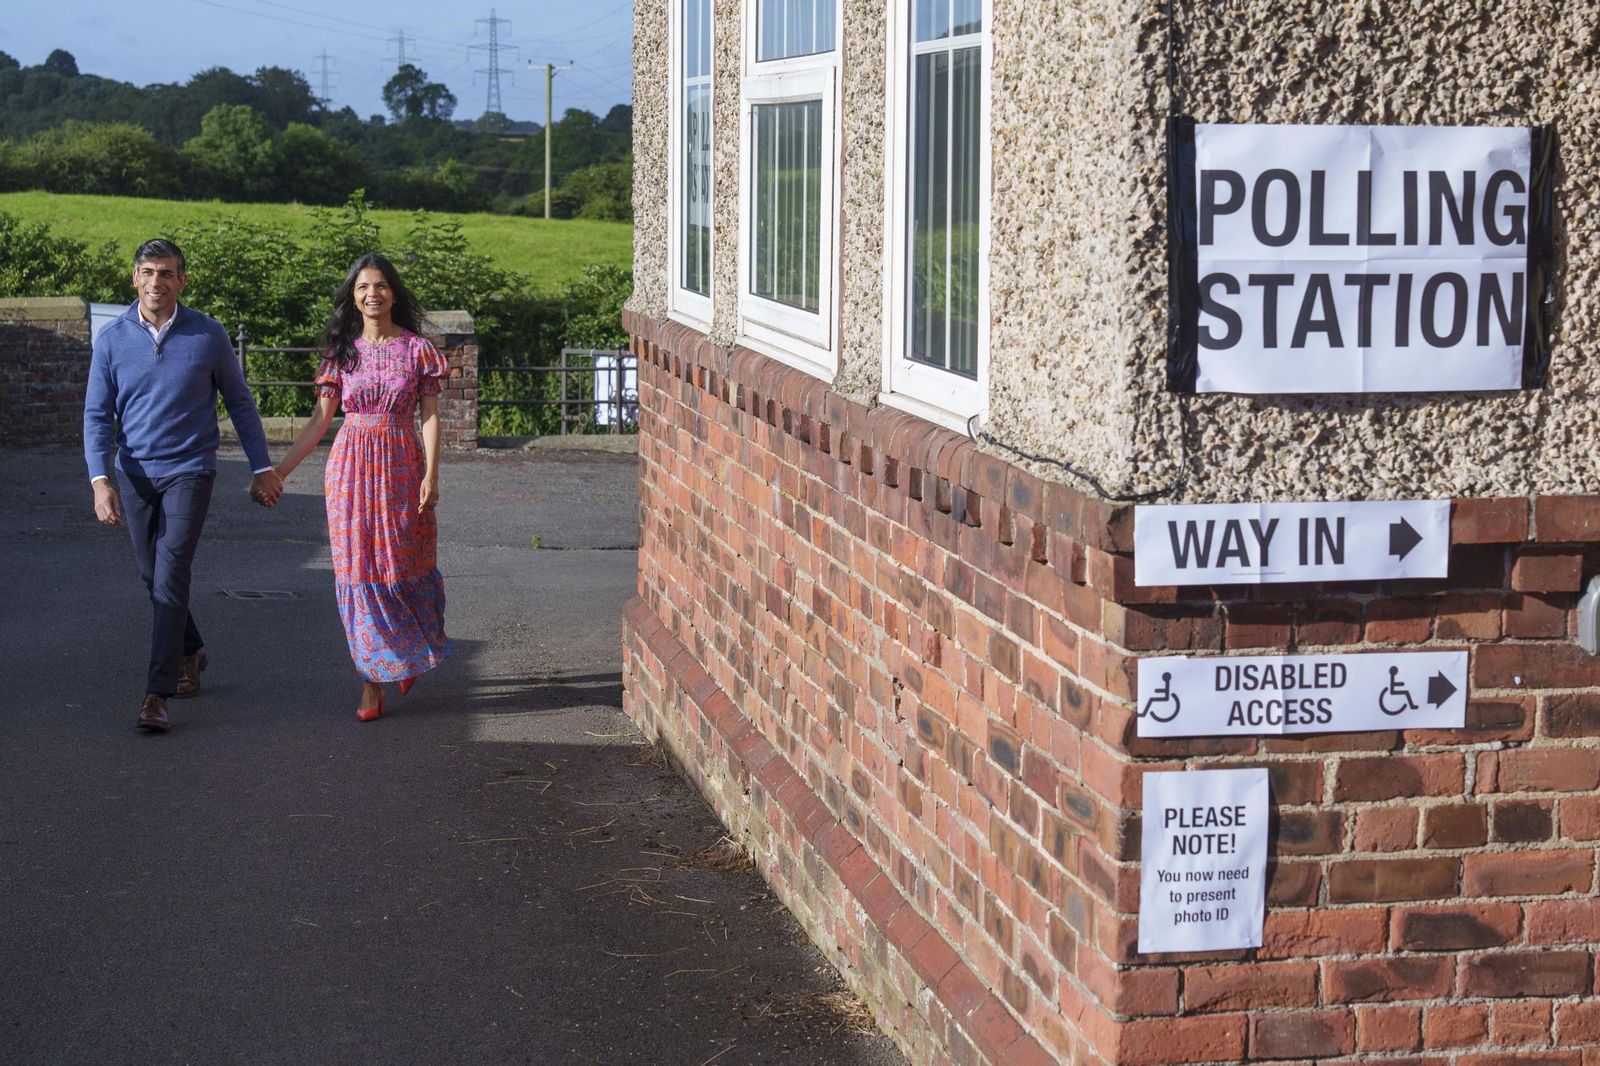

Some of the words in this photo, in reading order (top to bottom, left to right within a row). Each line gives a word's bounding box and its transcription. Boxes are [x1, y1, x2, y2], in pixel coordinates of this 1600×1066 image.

[1199, 168, 1527, 247] POLLING
[1197, 271, 1525, 350] STATION
[1167, 518, 1280, 569] WAY
[1298, 516, 1346, 566] IN
[1214, 662, 1347, 692] DISABLED
[1226, 697, 1333, 727] ACCESS
[1164, 805, 1246, 829] PLEASE
[1172, 833, 1236, 856] NOTE!
[1157, 869, 1181, 883] You
[1185, 870, 1214, 882] now
[1217, 866, 1250, 881] need
[1169, 889, 1182, 903] to
[1186, 887, 1236, 905] present
[1174, 909, 1212, 926] photo
[1215, 907, 1230, 921] ID
